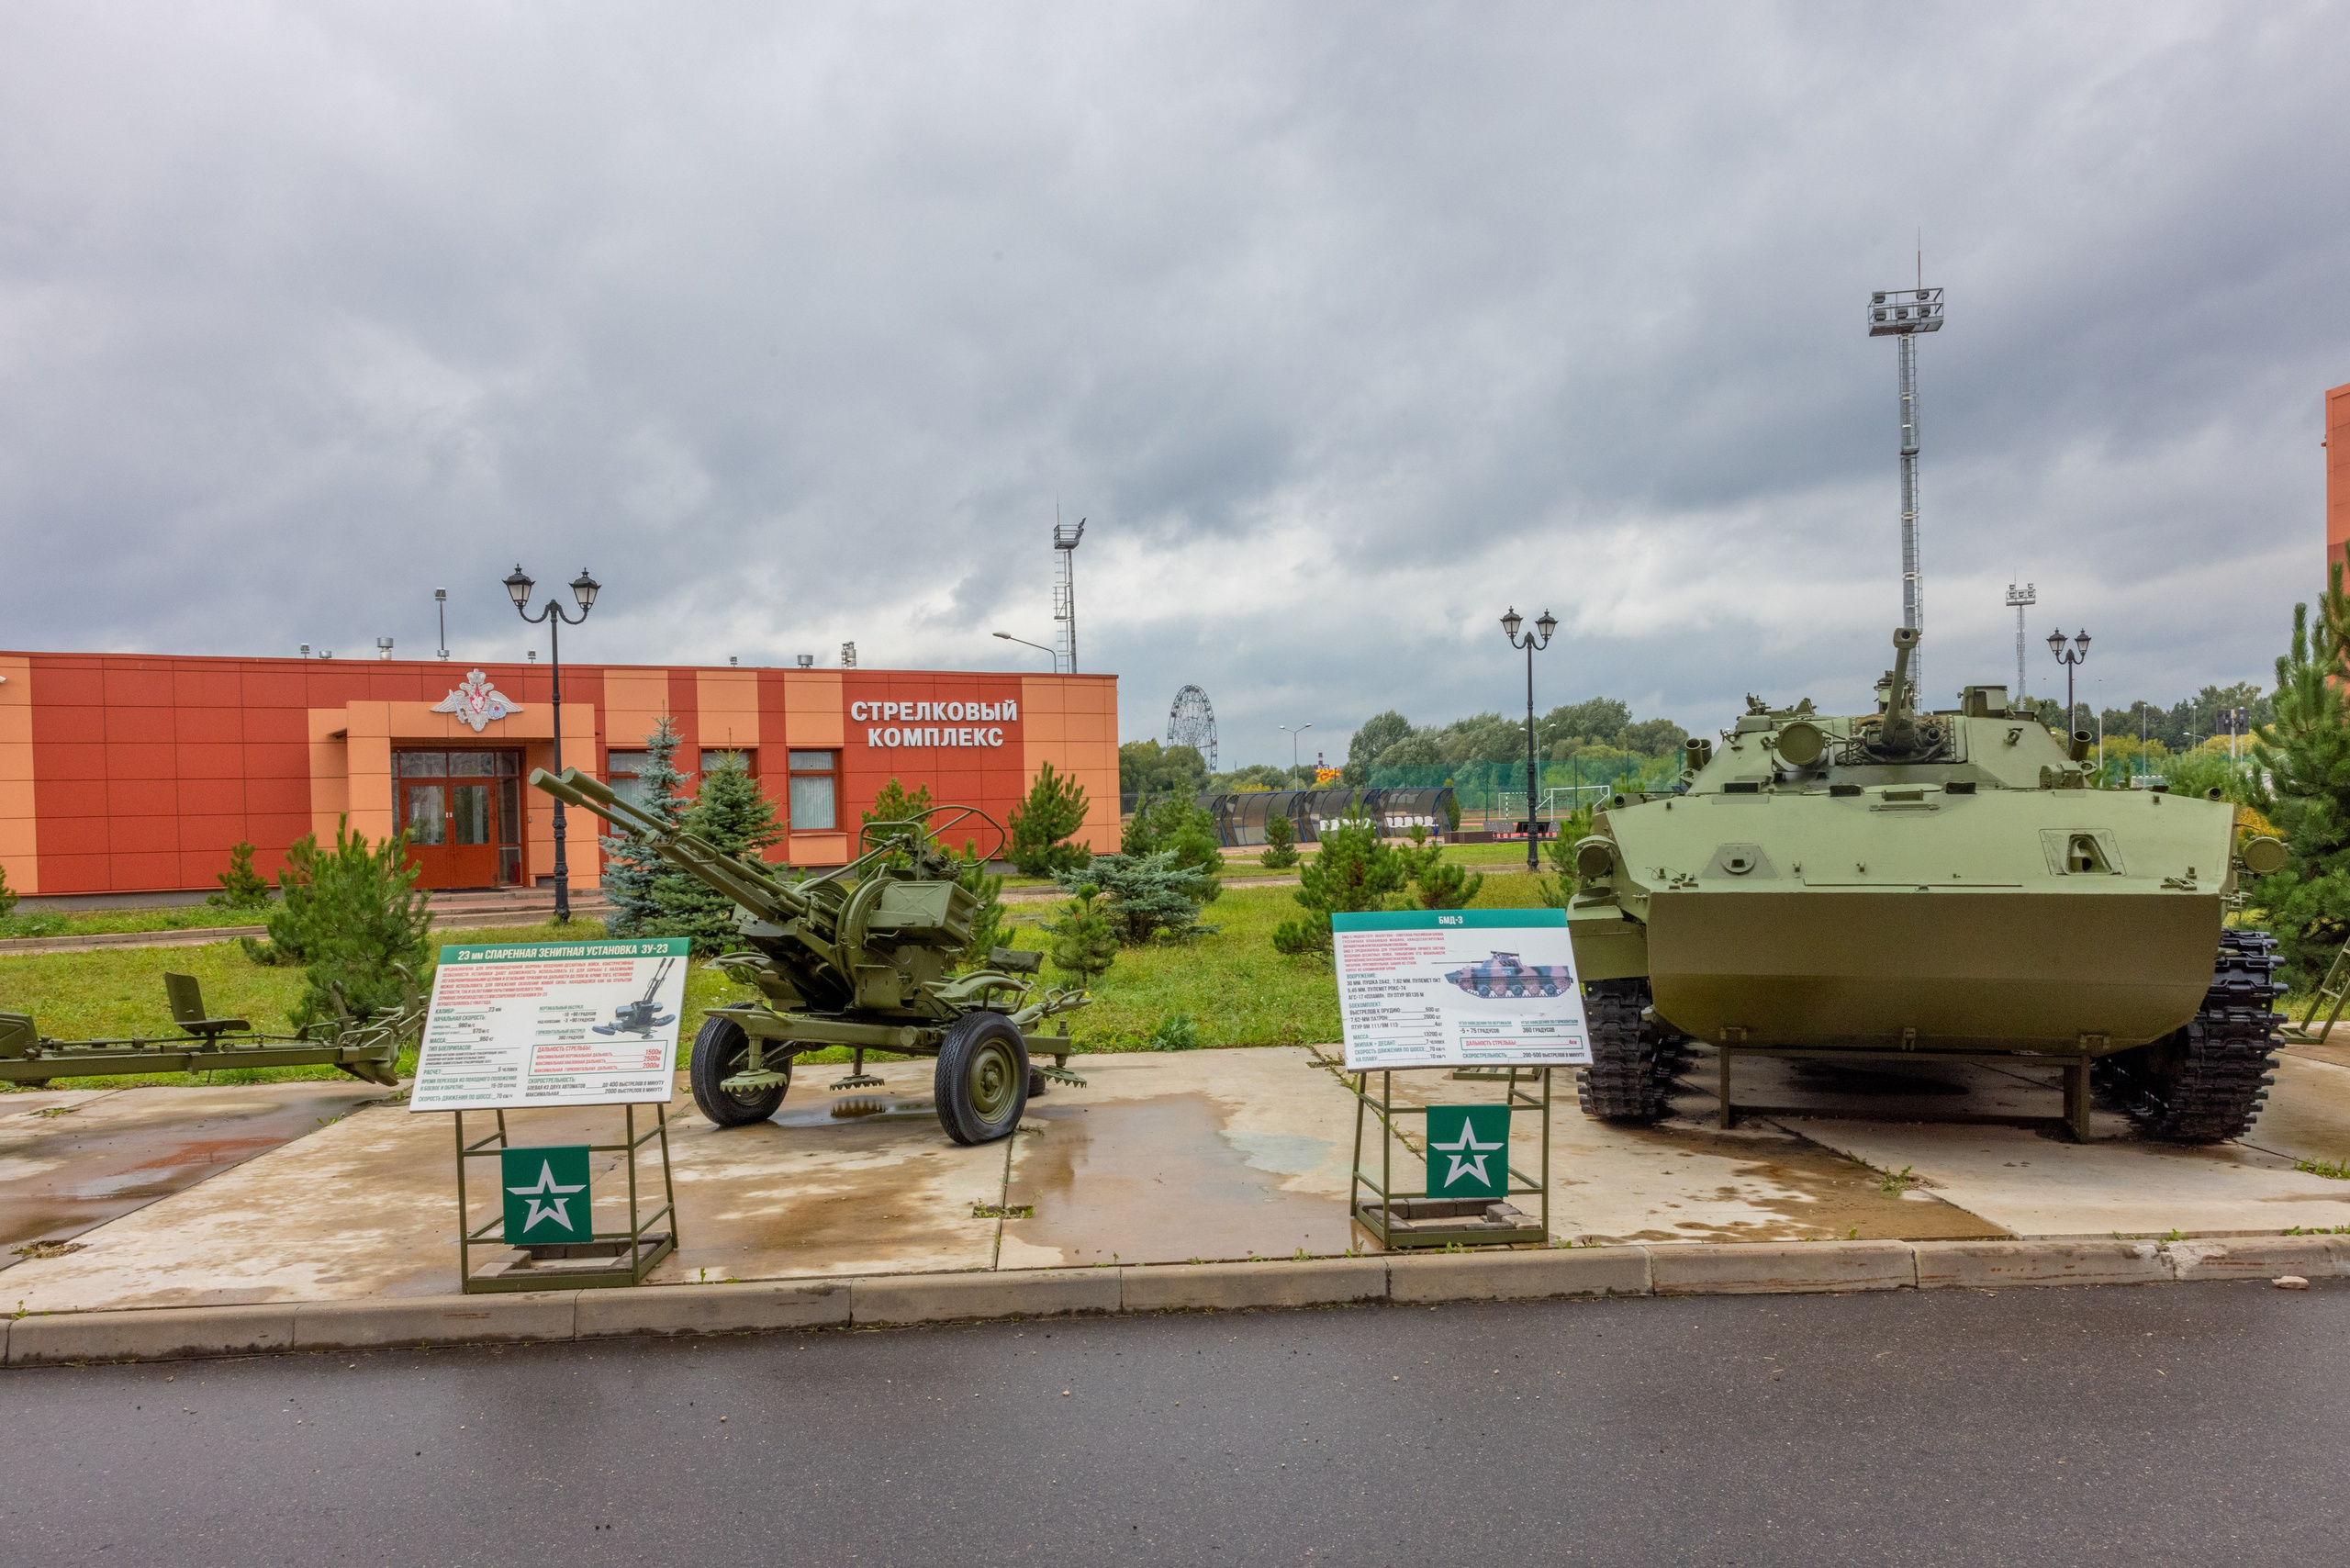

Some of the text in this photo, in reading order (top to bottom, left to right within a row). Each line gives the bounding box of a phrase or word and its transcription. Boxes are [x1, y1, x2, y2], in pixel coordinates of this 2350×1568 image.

[850, 700, 1017, 722] СТРЕЛКОВЫЙ
[868, 727, 1004, 747] КОМПЛЕКС
[1438, 915, 1463, 924] БМД-3
[457, 950, 470, 959] 23
[485, 948, 537, 958] СПАРЕННАЯ
[538, 946, 584, 957] ЗЕНИТНАЯ
[586, 944, 637, 956] УСТАНОВКА
